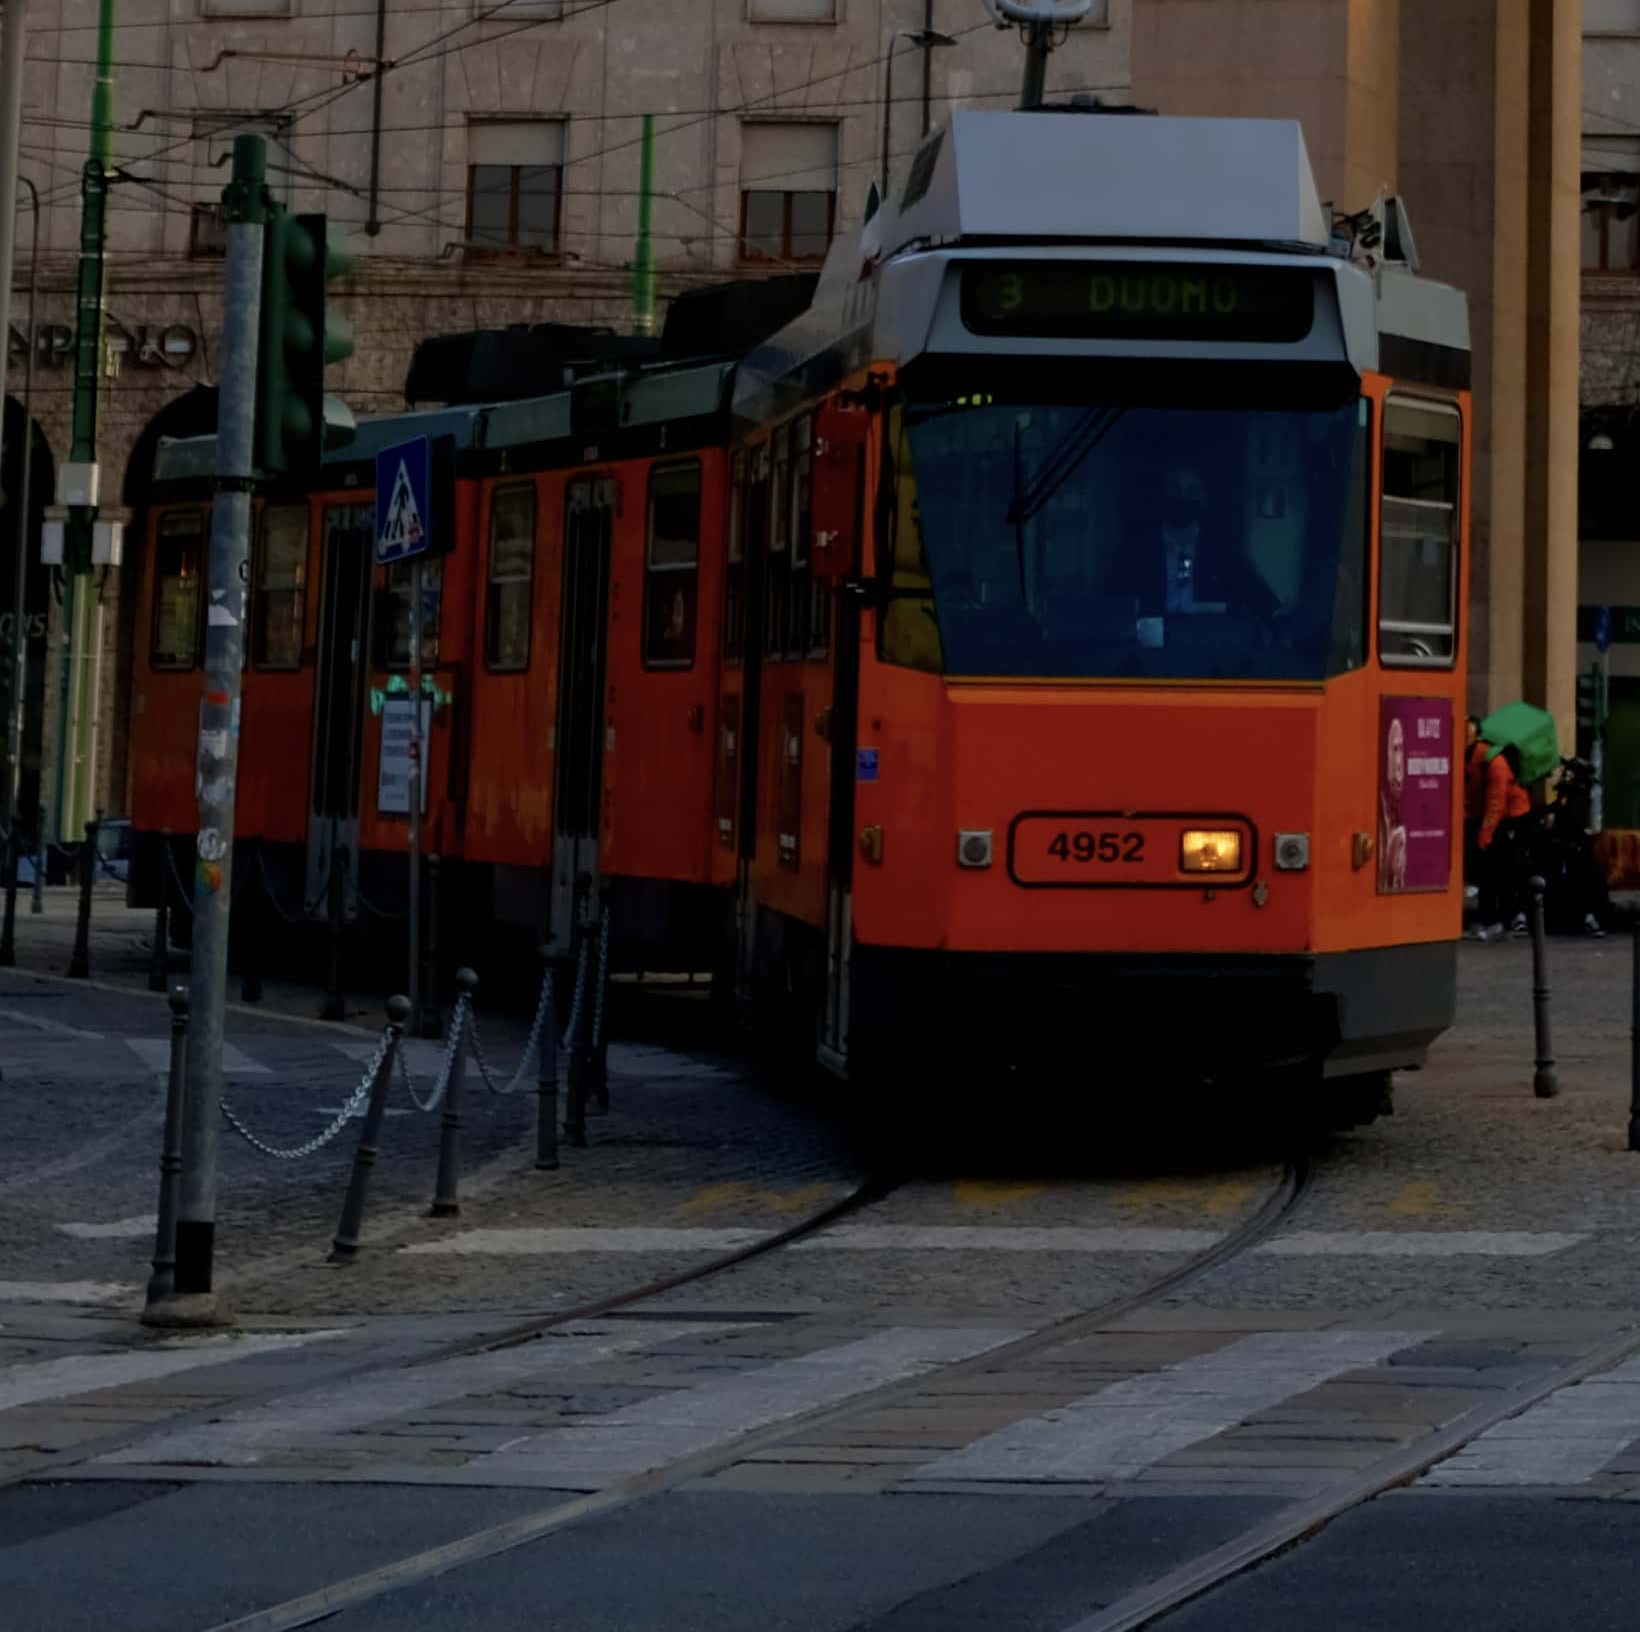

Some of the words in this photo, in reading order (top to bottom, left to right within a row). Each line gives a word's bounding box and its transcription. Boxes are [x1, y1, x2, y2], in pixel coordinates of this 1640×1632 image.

[998, 272, 1024, 311] 3
[1088, 273, 1240, 315] DUOMO
[1047, 832, 1145, 863] 4952
